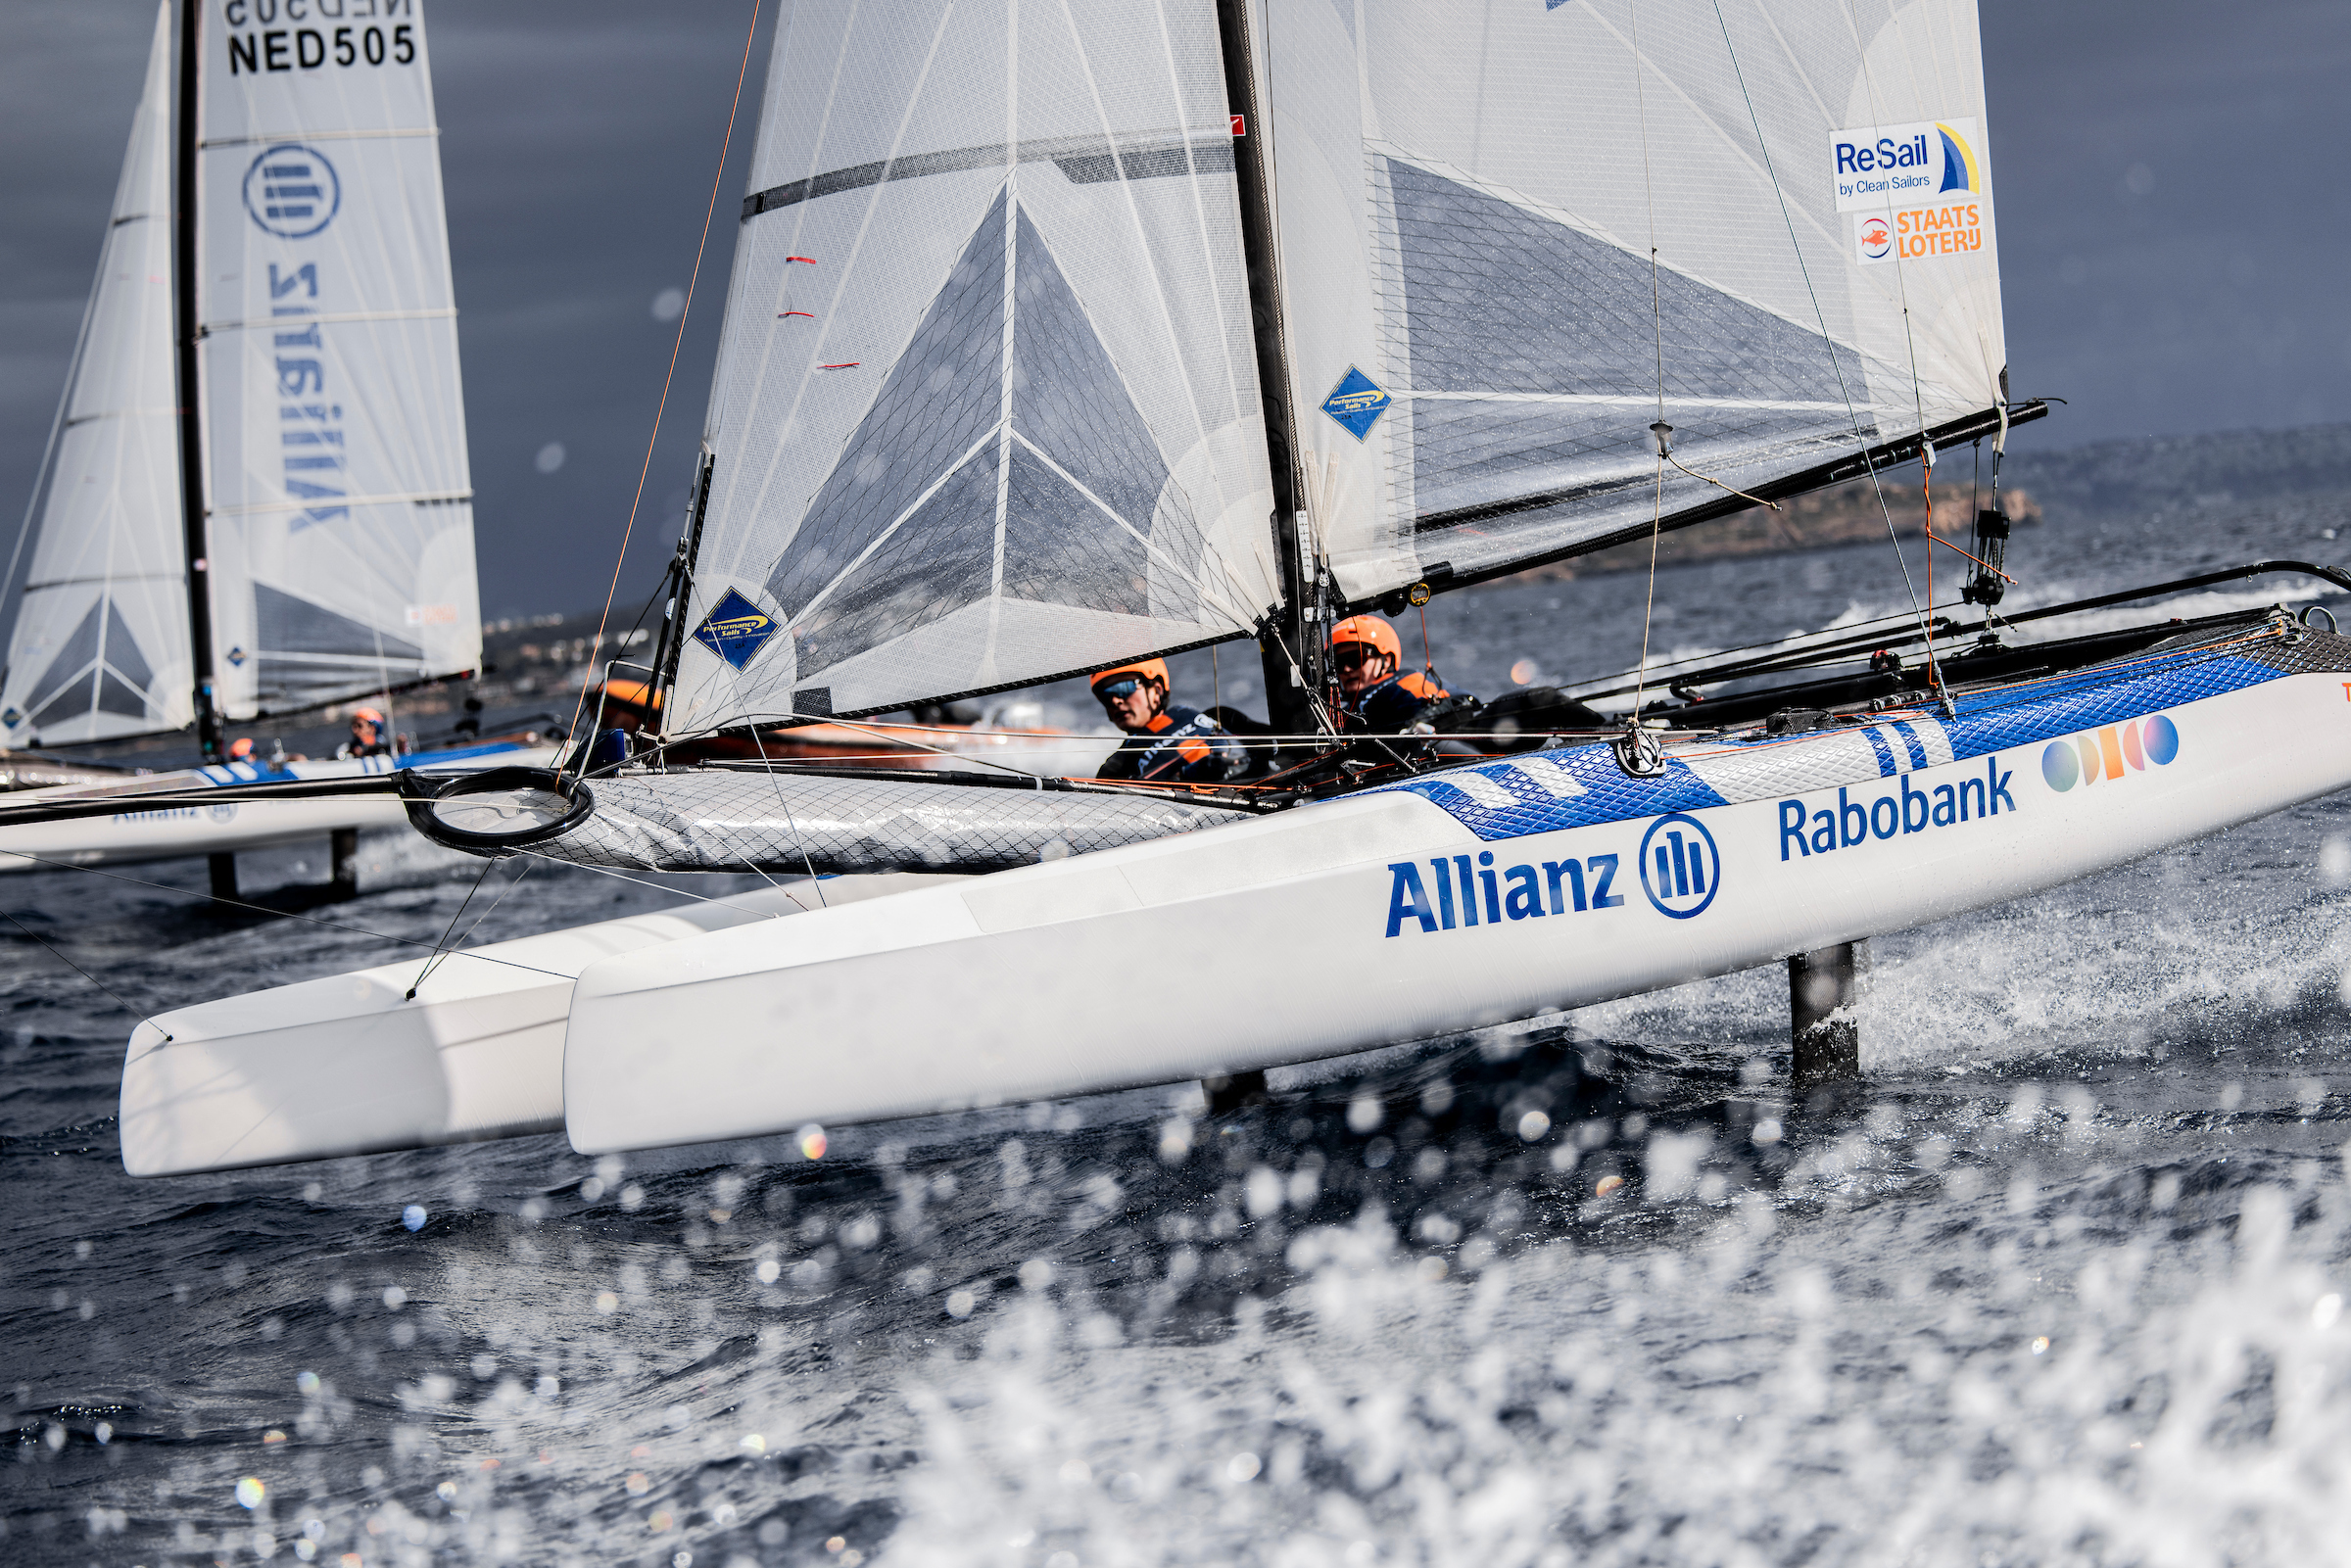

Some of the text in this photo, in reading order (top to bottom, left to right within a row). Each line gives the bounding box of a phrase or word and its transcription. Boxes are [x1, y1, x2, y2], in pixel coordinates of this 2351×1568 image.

[228, 24, 415, 75] NED505
[1836, 134, 1928, 174] ReSail
[1839, 175, 1930, 197] by Clean Sailors
[1896, 204, 1980, 234] STAATS
[1897, 228, 1982, 259] LOTERIJ
[1329, 396, 1375, 405] Performance
[1778, 756, 2016, 862] Rabobank
[1385, 850, 1625, 938] Allianz
